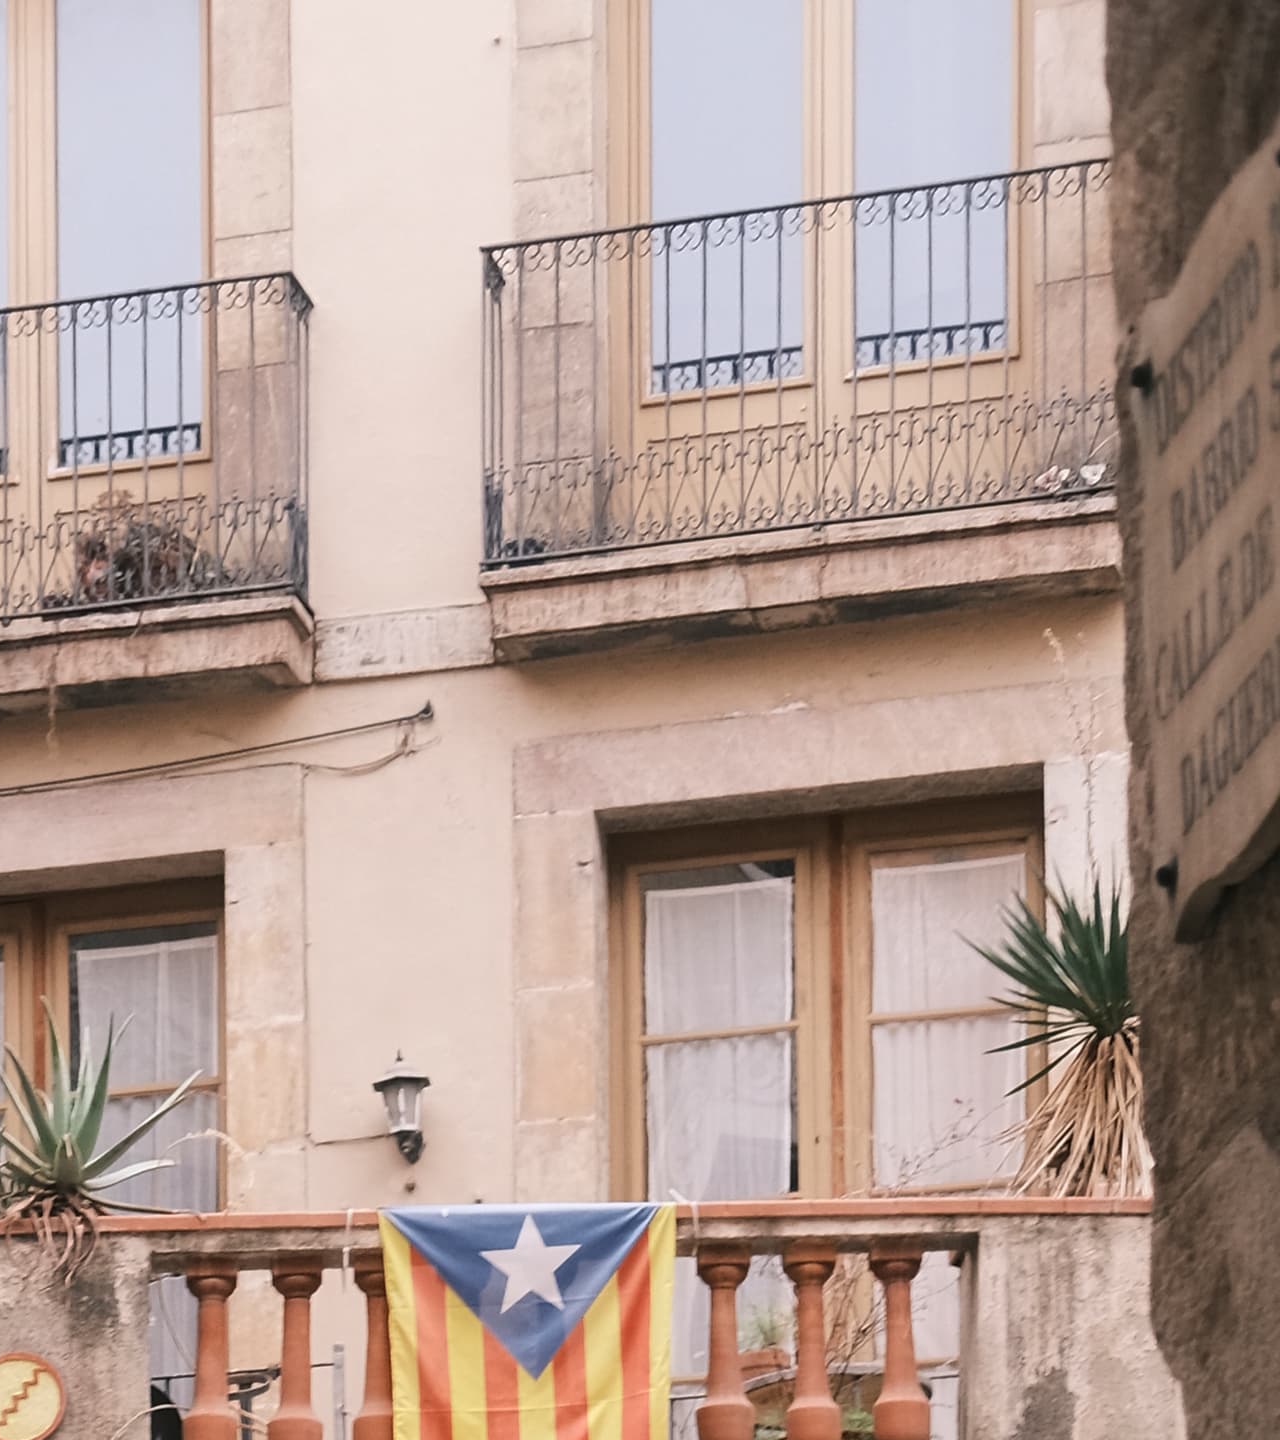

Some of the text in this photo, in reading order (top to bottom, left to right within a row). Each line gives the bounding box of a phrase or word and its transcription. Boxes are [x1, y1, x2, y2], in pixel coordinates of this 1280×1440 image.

[1155, 239, 1262, 456] DISTRITO
[1170, 384, 1258, 575] BARRIO
[1154, 556, 1234, 722] CALLE
